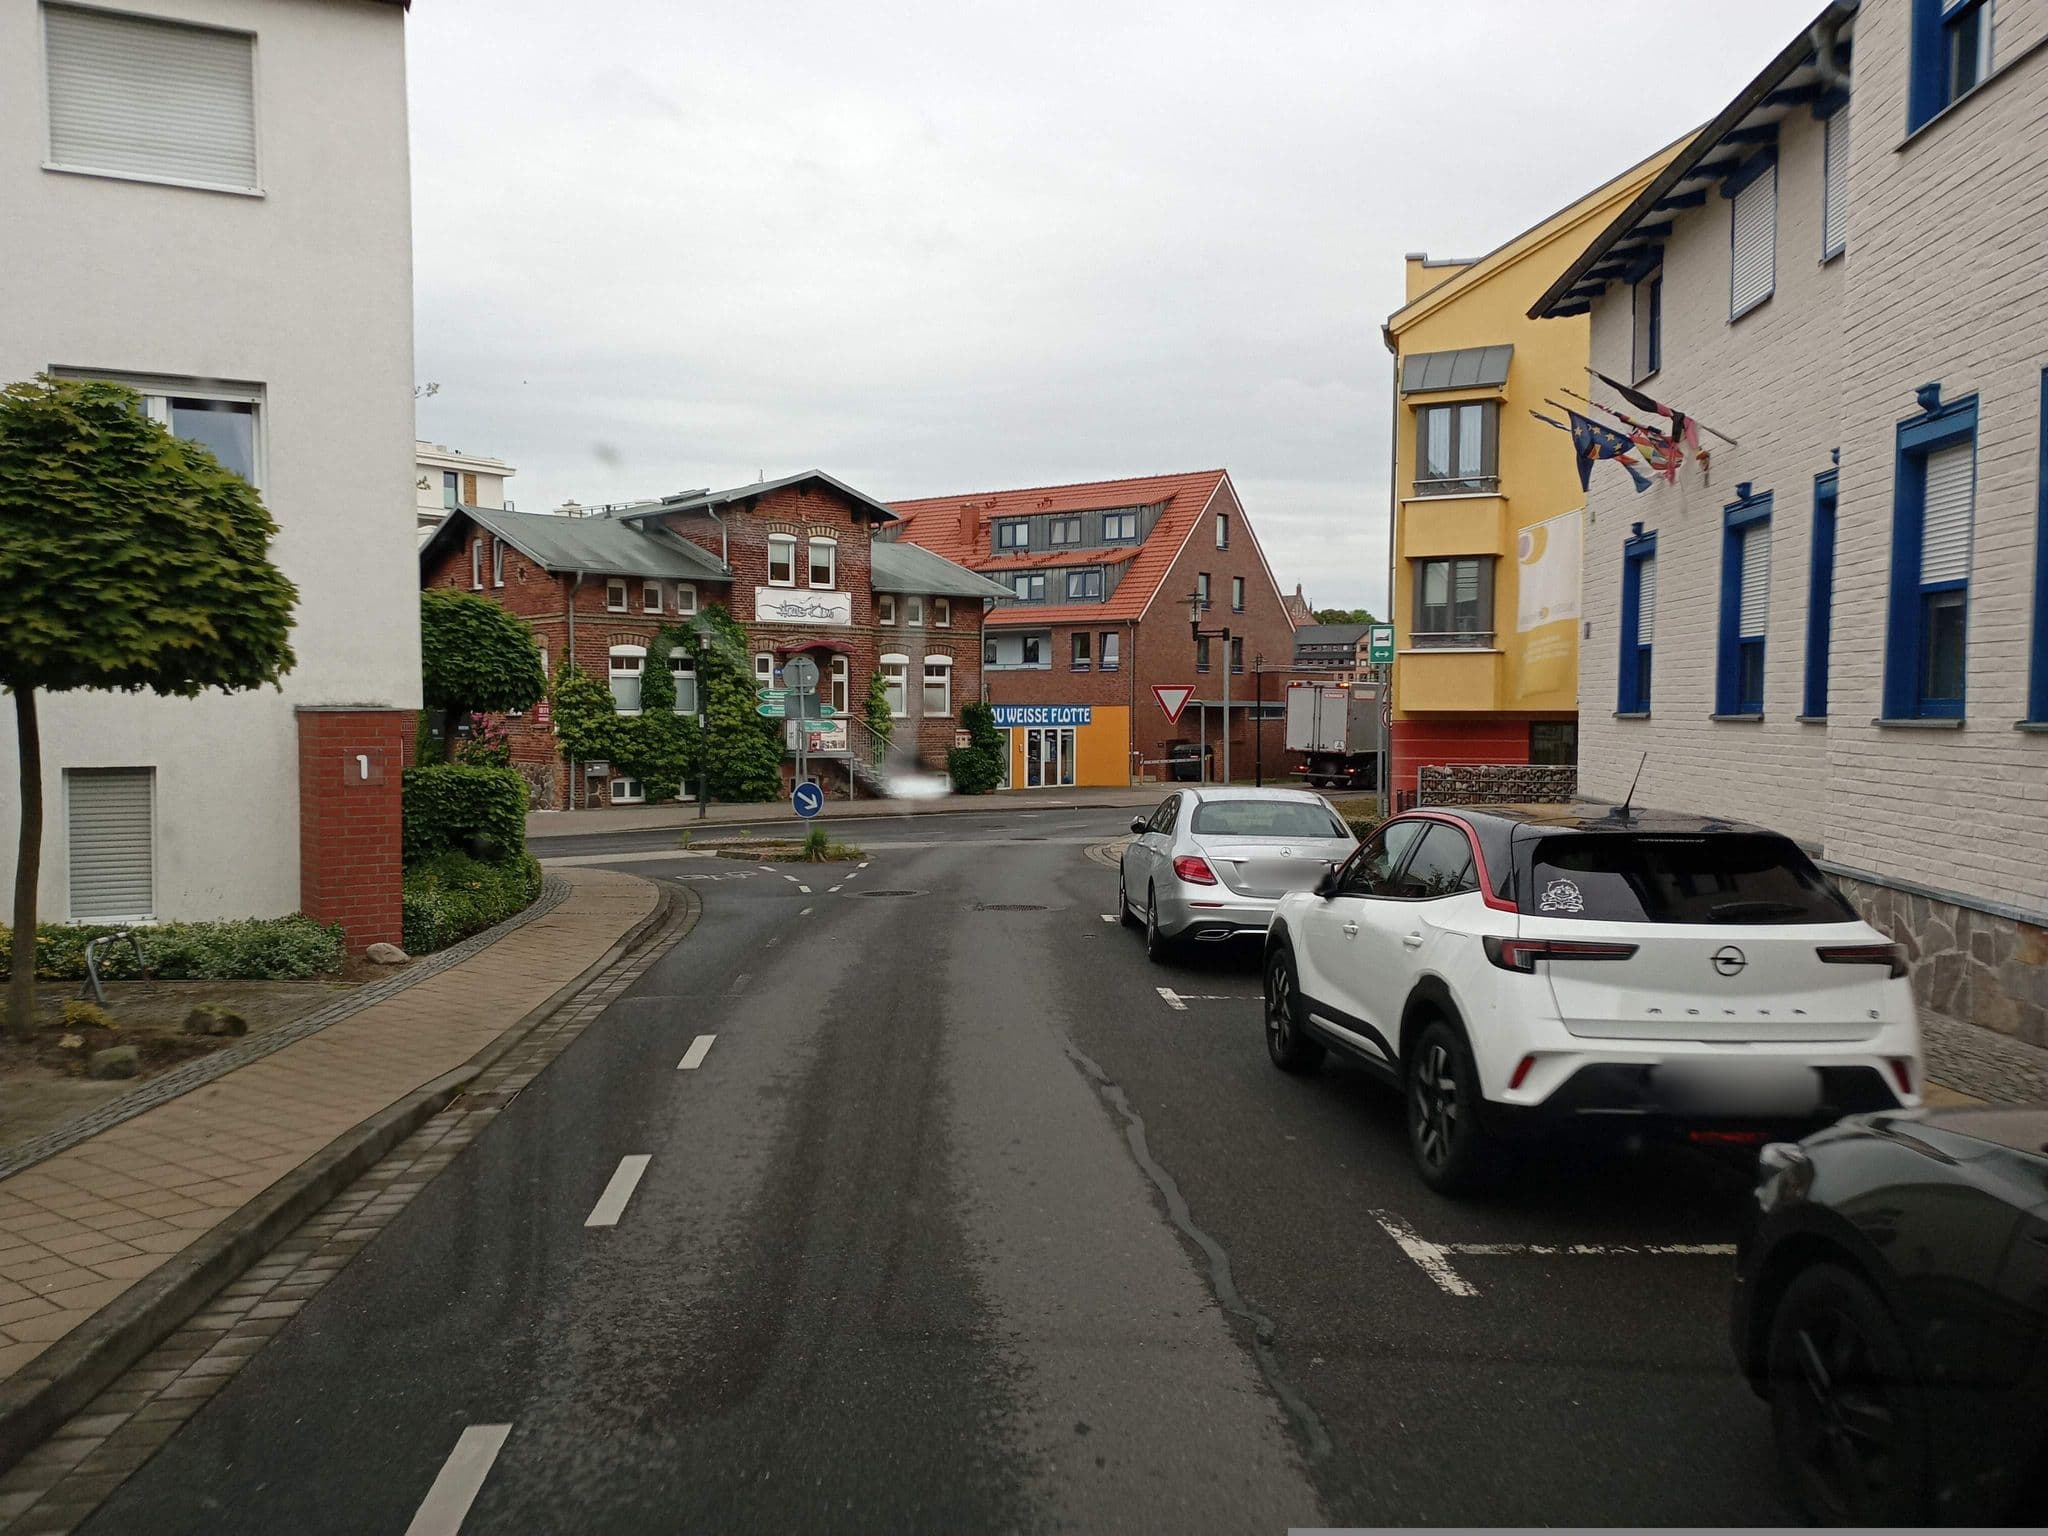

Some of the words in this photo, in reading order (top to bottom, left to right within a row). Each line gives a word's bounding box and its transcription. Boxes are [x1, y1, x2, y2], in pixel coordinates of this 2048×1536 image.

[1007, 708, 1048, 723] WEISSE
[1051, 708, 1091, 723] FLOTTE
[356, 755, 368, 779] 1
